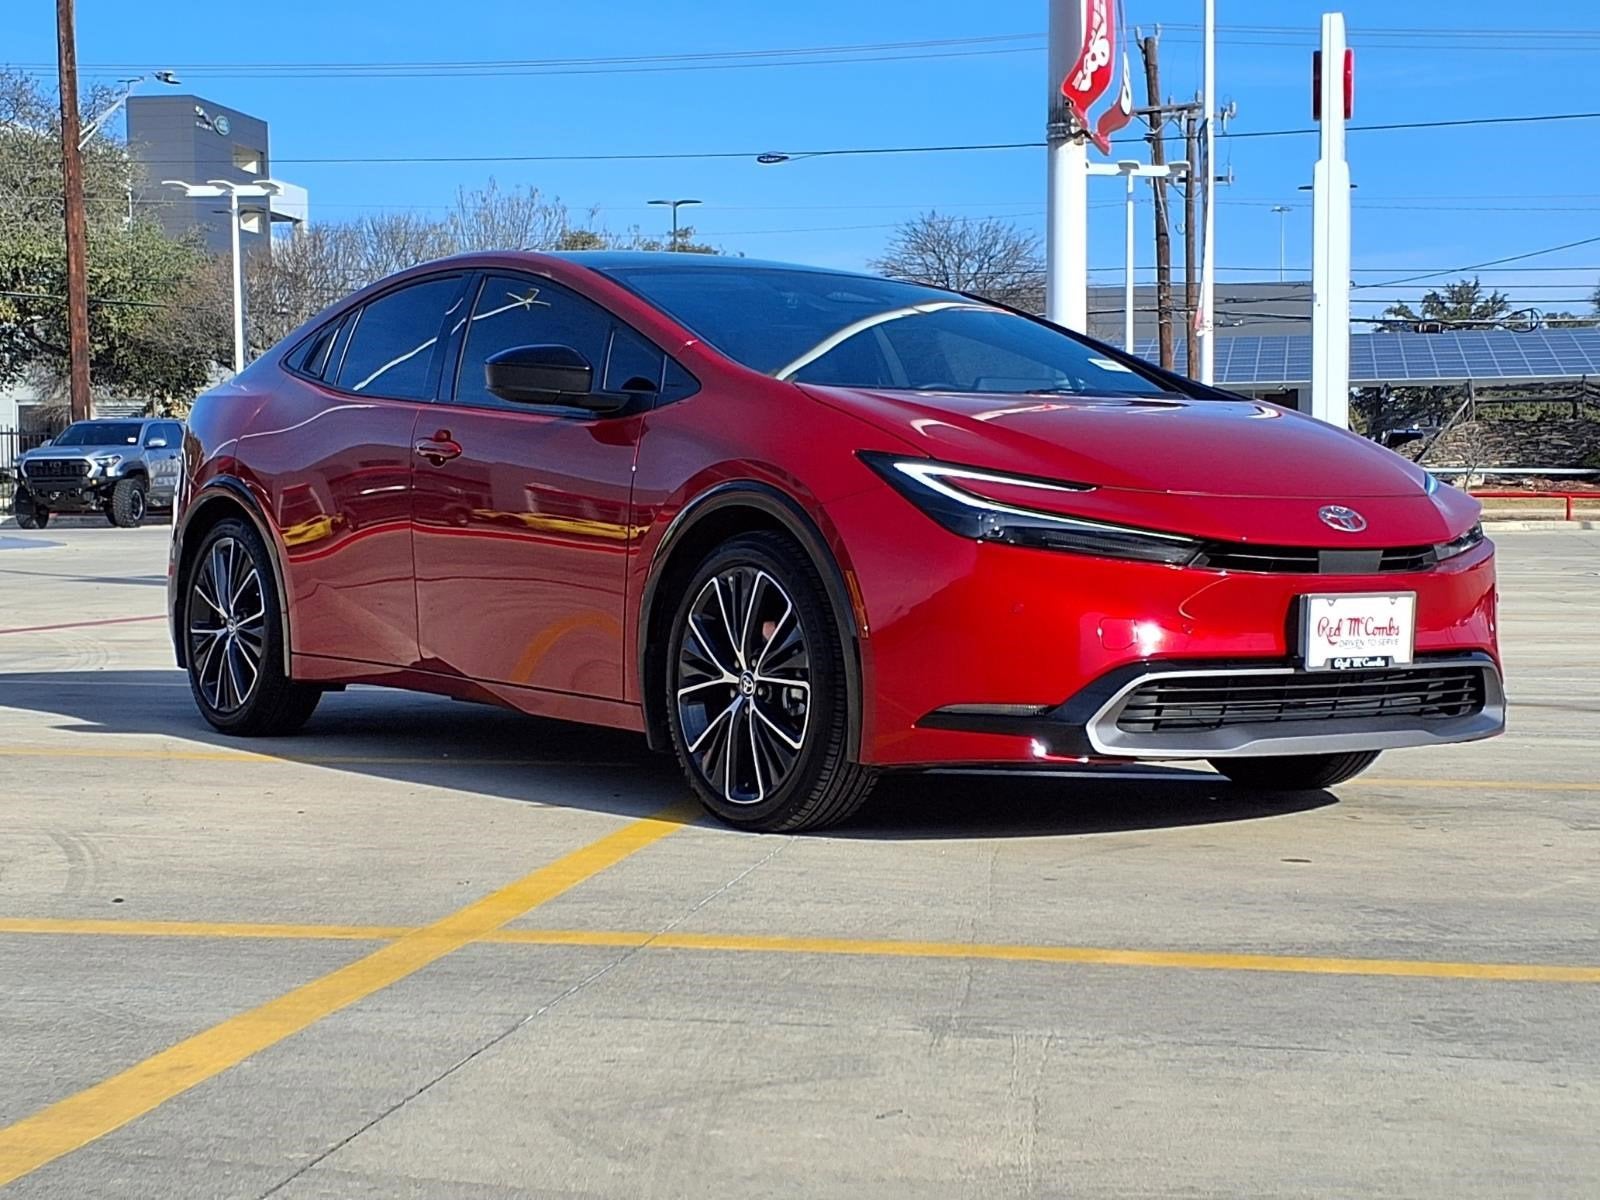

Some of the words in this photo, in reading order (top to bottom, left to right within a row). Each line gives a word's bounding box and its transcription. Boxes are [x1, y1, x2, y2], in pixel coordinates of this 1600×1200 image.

[1317, 616, 1343, 646] Red
[1346, 616, 1400, 637] McCombs
[1339, 639, 1365, 648] DRIVEN
[1378, 638, 1399, 646] SERVE
